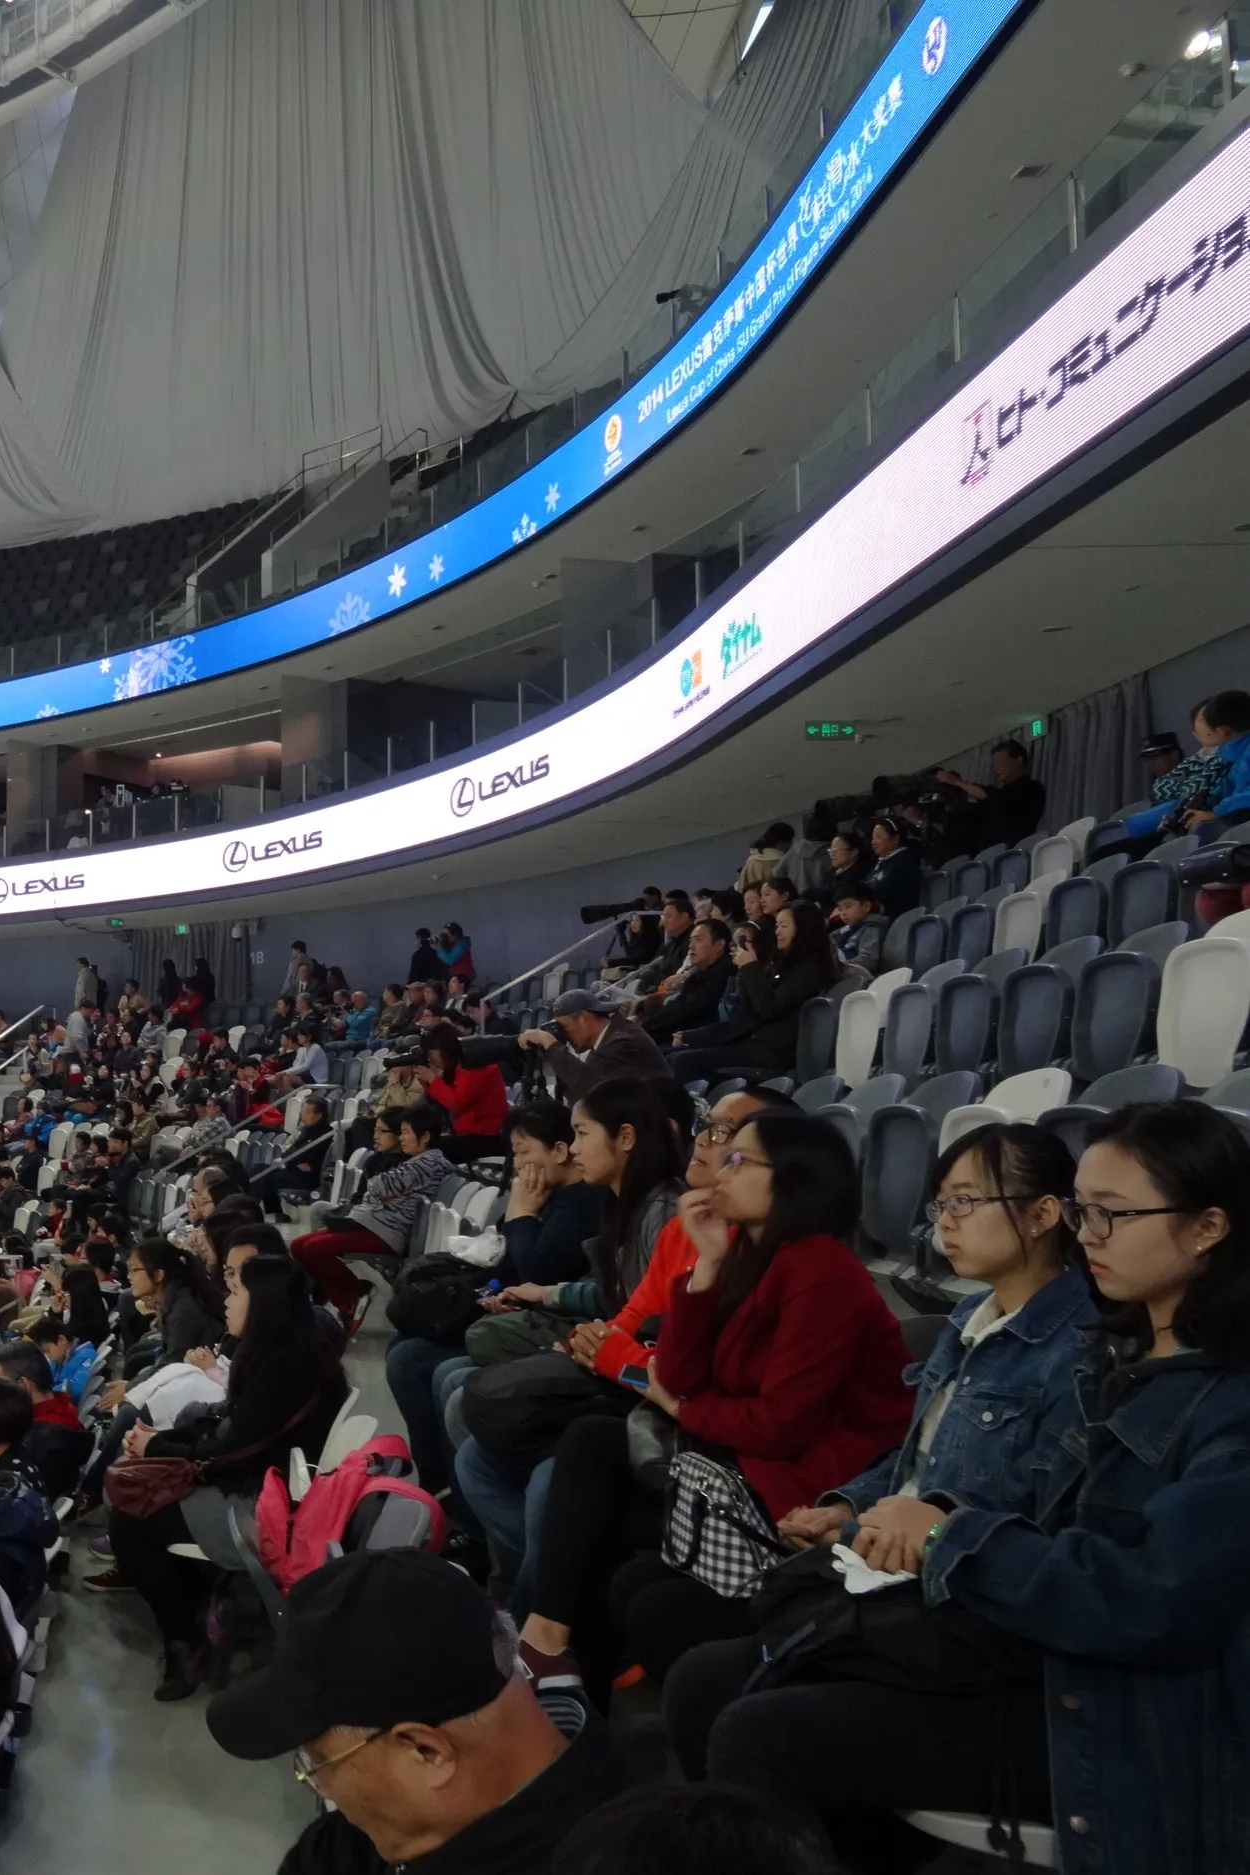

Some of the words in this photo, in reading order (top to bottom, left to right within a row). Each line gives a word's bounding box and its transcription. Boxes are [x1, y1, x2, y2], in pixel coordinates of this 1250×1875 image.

[478, 754, 550, 801] LEXUS
[251, 830, 322, 862] LEXUS
[12, 874, 85, 896] LEXUS
